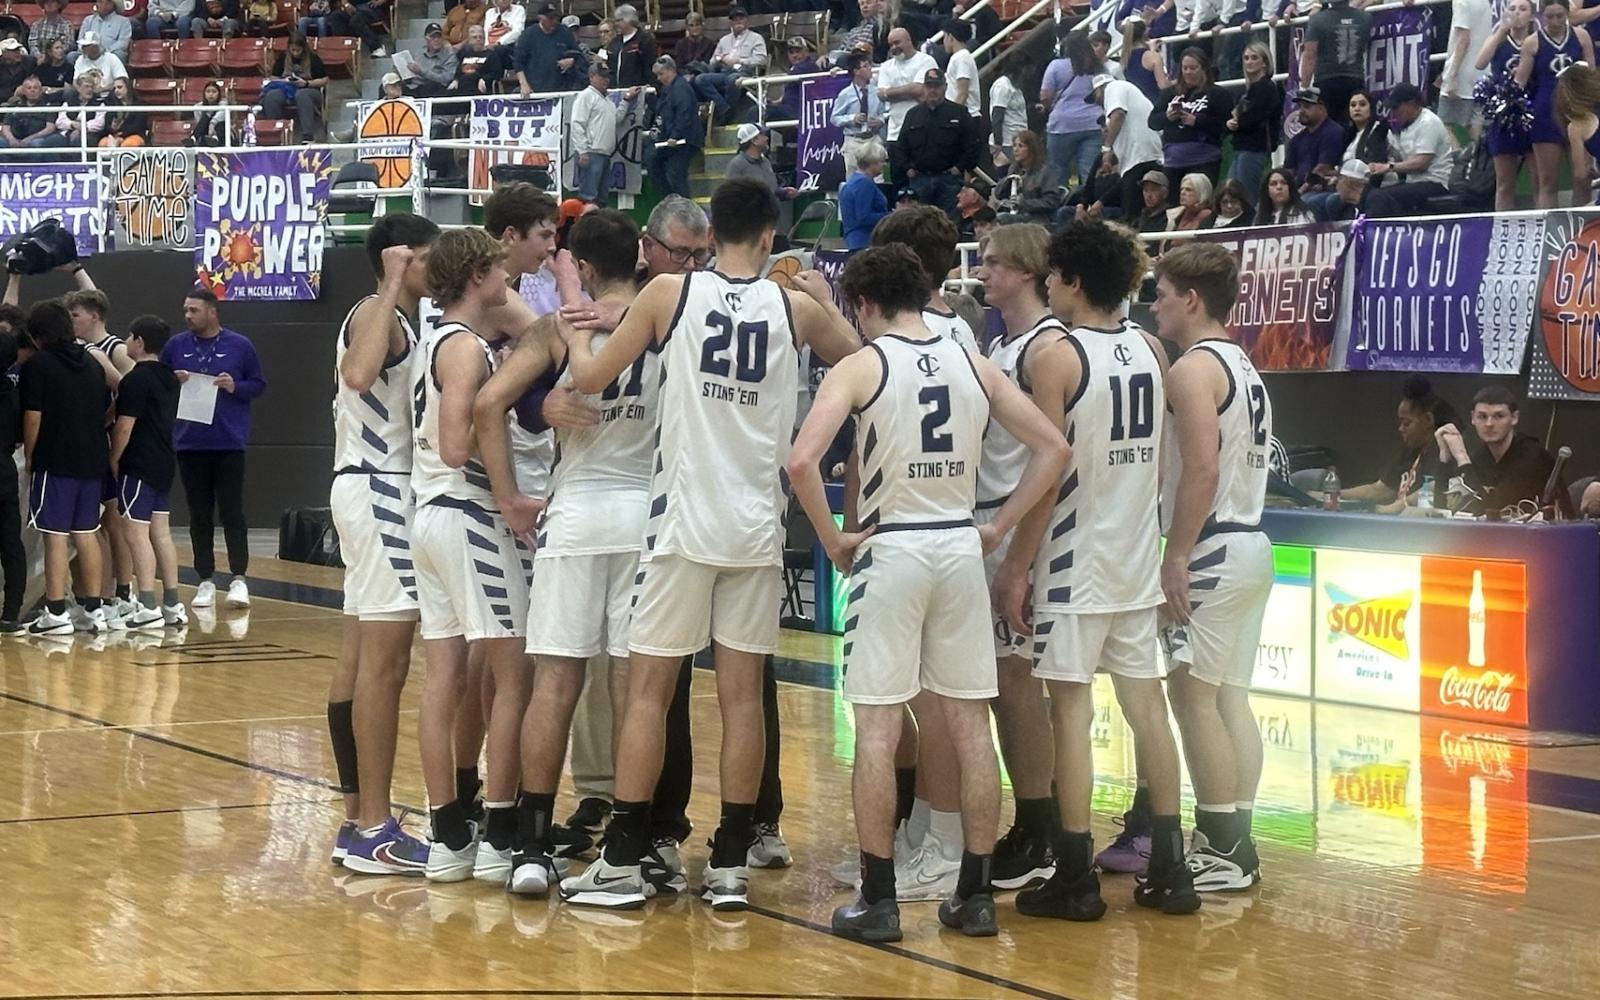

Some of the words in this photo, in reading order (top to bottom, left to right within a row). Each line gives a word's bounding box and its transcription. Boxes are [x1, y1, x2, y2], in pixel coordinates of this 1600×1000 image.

[487, 119, 546, 139] BUT
[806, 99, 834, 130] LET'
[212, 172, 318, 222] PURPLE
[1241, 236, 1309, 273] FIRED
[1315, 231, 1346, 269] UP
[1370, 223, 1424, 289] LET'S
[1429, 223, 1461, 288] GO
[1225, 265, 1336, 328] RNETS
[700, 309, 769, 383] 20
[1361, 294, 1470, 352] HORNETS
[702, 381, 734, 402] STING
[1109, 372, 1154, 441] 10
[918, 384, 954, 454] 2
[908, 461, 943, 479] STING
[945, 459, 965, 477] 'EM
[1108, 448, 1135, 466] STING
[1330, 602, 1408, 641] SONIC
